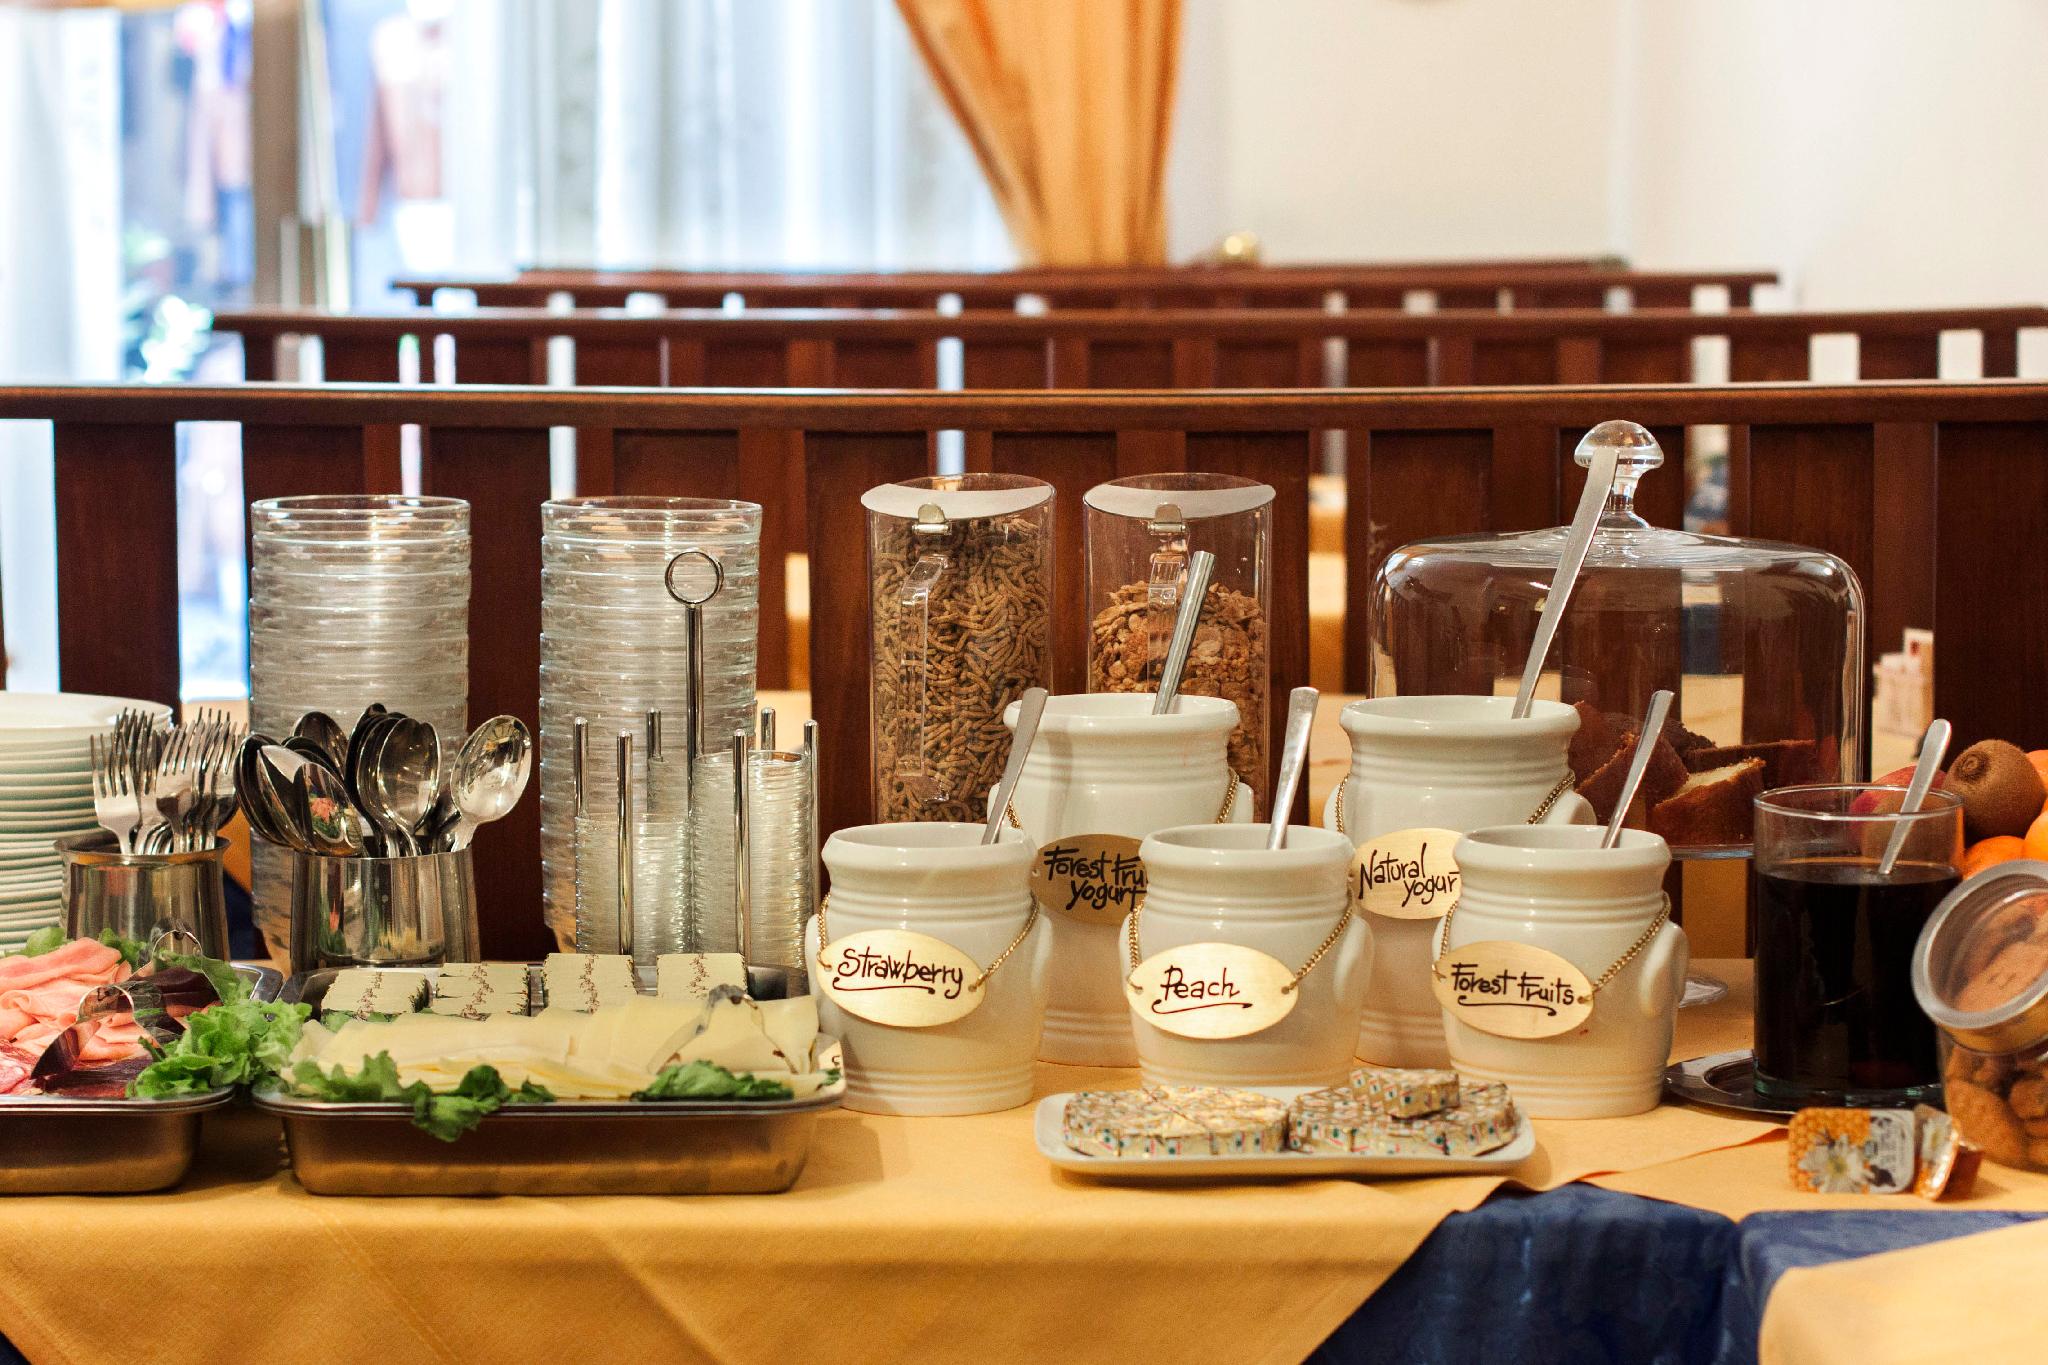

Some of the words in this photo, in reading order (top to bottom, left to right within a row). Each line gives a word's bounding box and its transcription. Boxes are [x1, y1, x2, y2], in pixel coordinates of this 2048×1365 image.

[1043, 846, 1113, 882] Forest
[1110, 853, 1149, 888] Fru
[1358, 842, 1427, 900] Natural
[837, 946, 963, 999] Strawberry
[1160, 965, 1241, 1001] Peach
[1451, 962, 1518, 995] Forest
[1517, 971, 1575, 1006] Fruits
